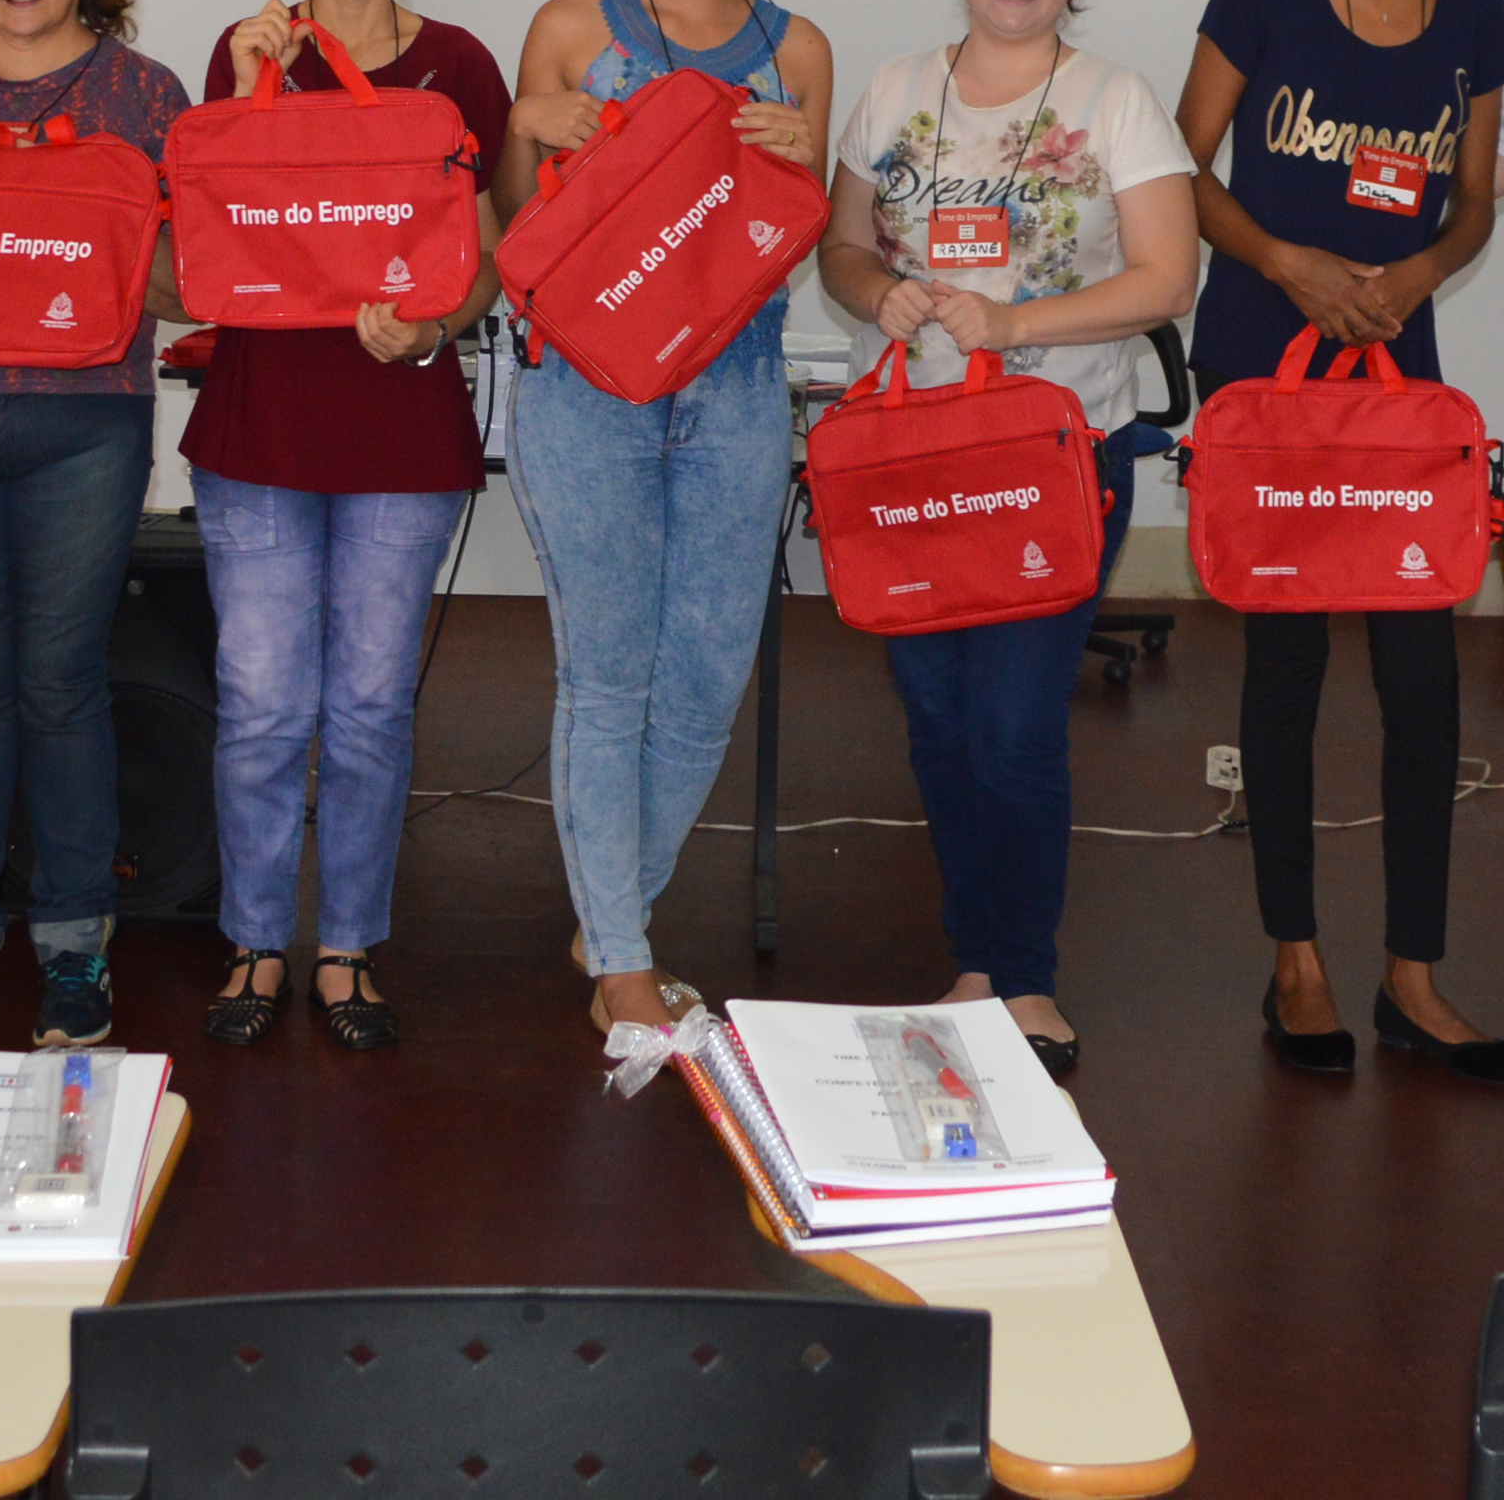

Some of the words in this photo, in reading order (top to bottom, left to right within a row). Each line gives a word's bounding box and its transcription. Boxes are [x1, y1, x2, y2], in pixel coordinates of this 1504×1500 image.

[877, 160, 1058, 206] Dreams
[227, 204, 279, 225] Time
[284, 202, 313, 224] do
[318, 201, 414, 226] Emprego
[0, 232, 92, 262] Emprego
[595, 269, 644, 312] Time
[640, 246, 667, 272] do
[658, 174, 735, 250] Emprego
[939, 242, 999, 257] RAYANE
[870, 505, 919, 527] Time
[923, 498, 949, 519] do
[950, 486, 1041, 515] Emprego
[1254, 485, 1304, 507] Time
[1309, 485, 1336, 507] do
[1340, 485, 1434, 512] Emprego
